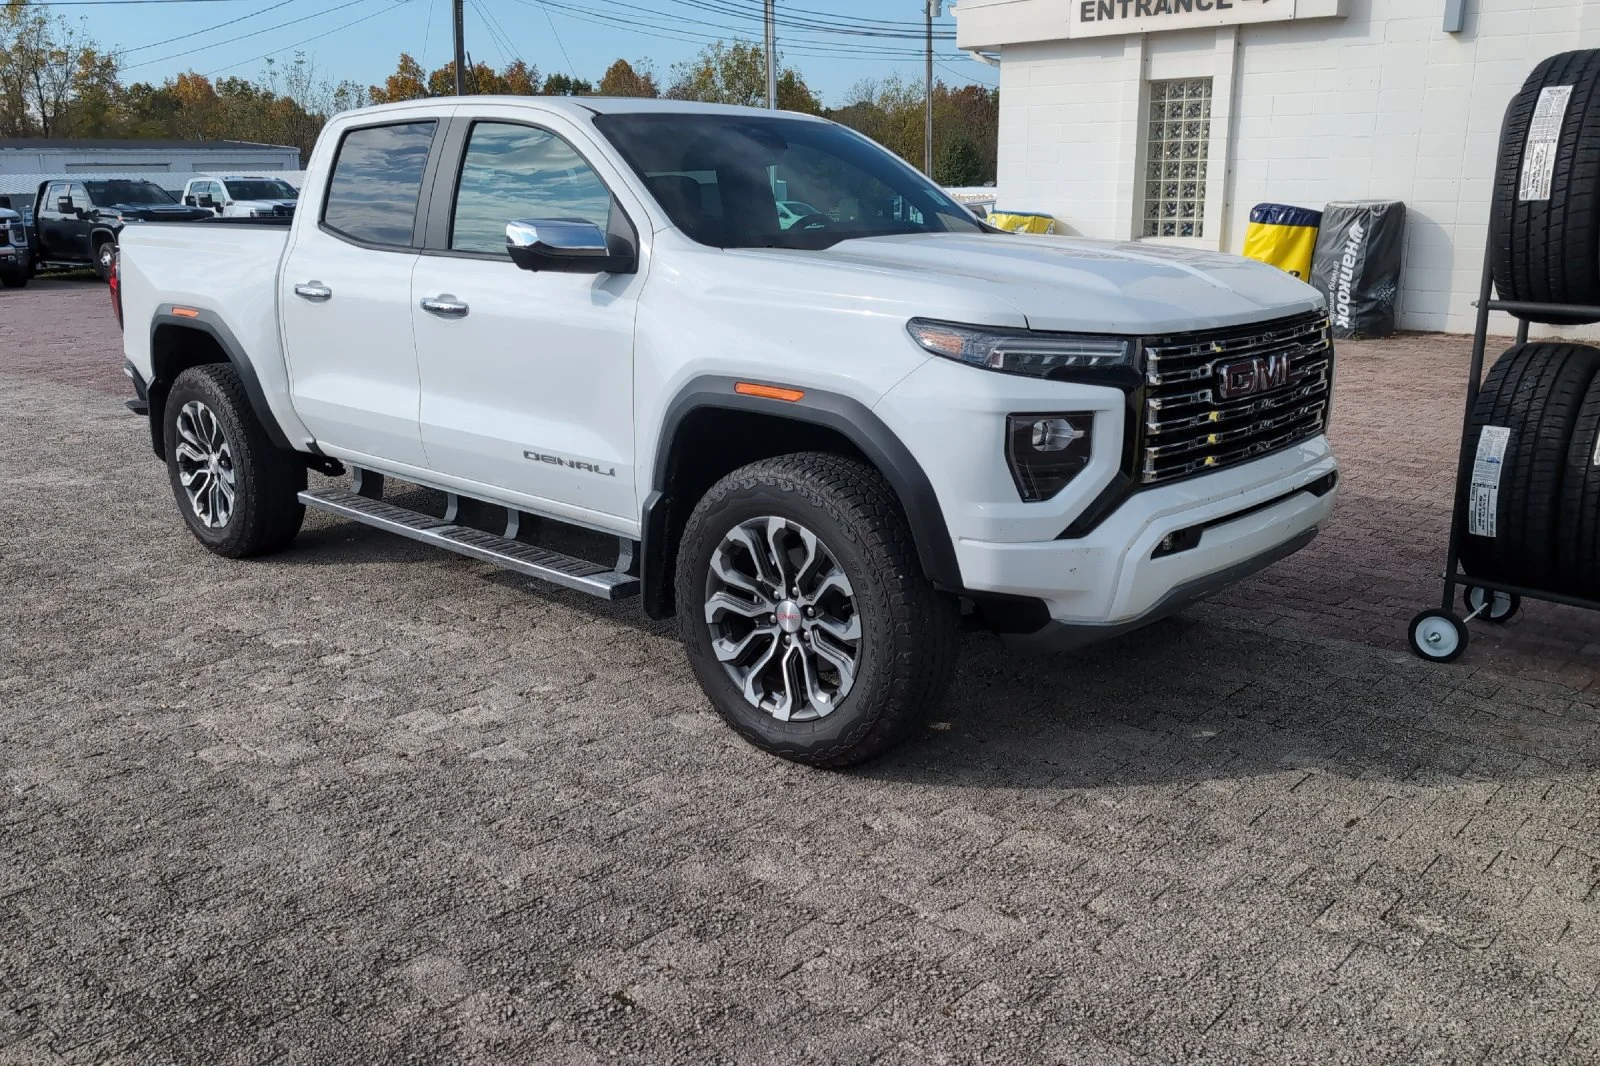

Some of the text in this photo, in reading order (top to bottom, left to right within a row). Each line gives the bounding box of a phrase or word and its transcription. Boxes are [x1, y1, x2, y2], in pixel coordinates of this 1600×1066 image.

[1336, 240, 1360, 330] Hankook
[1219, 351, 1311, 399] GMC
[523, 449, 616, 477] DENALI
